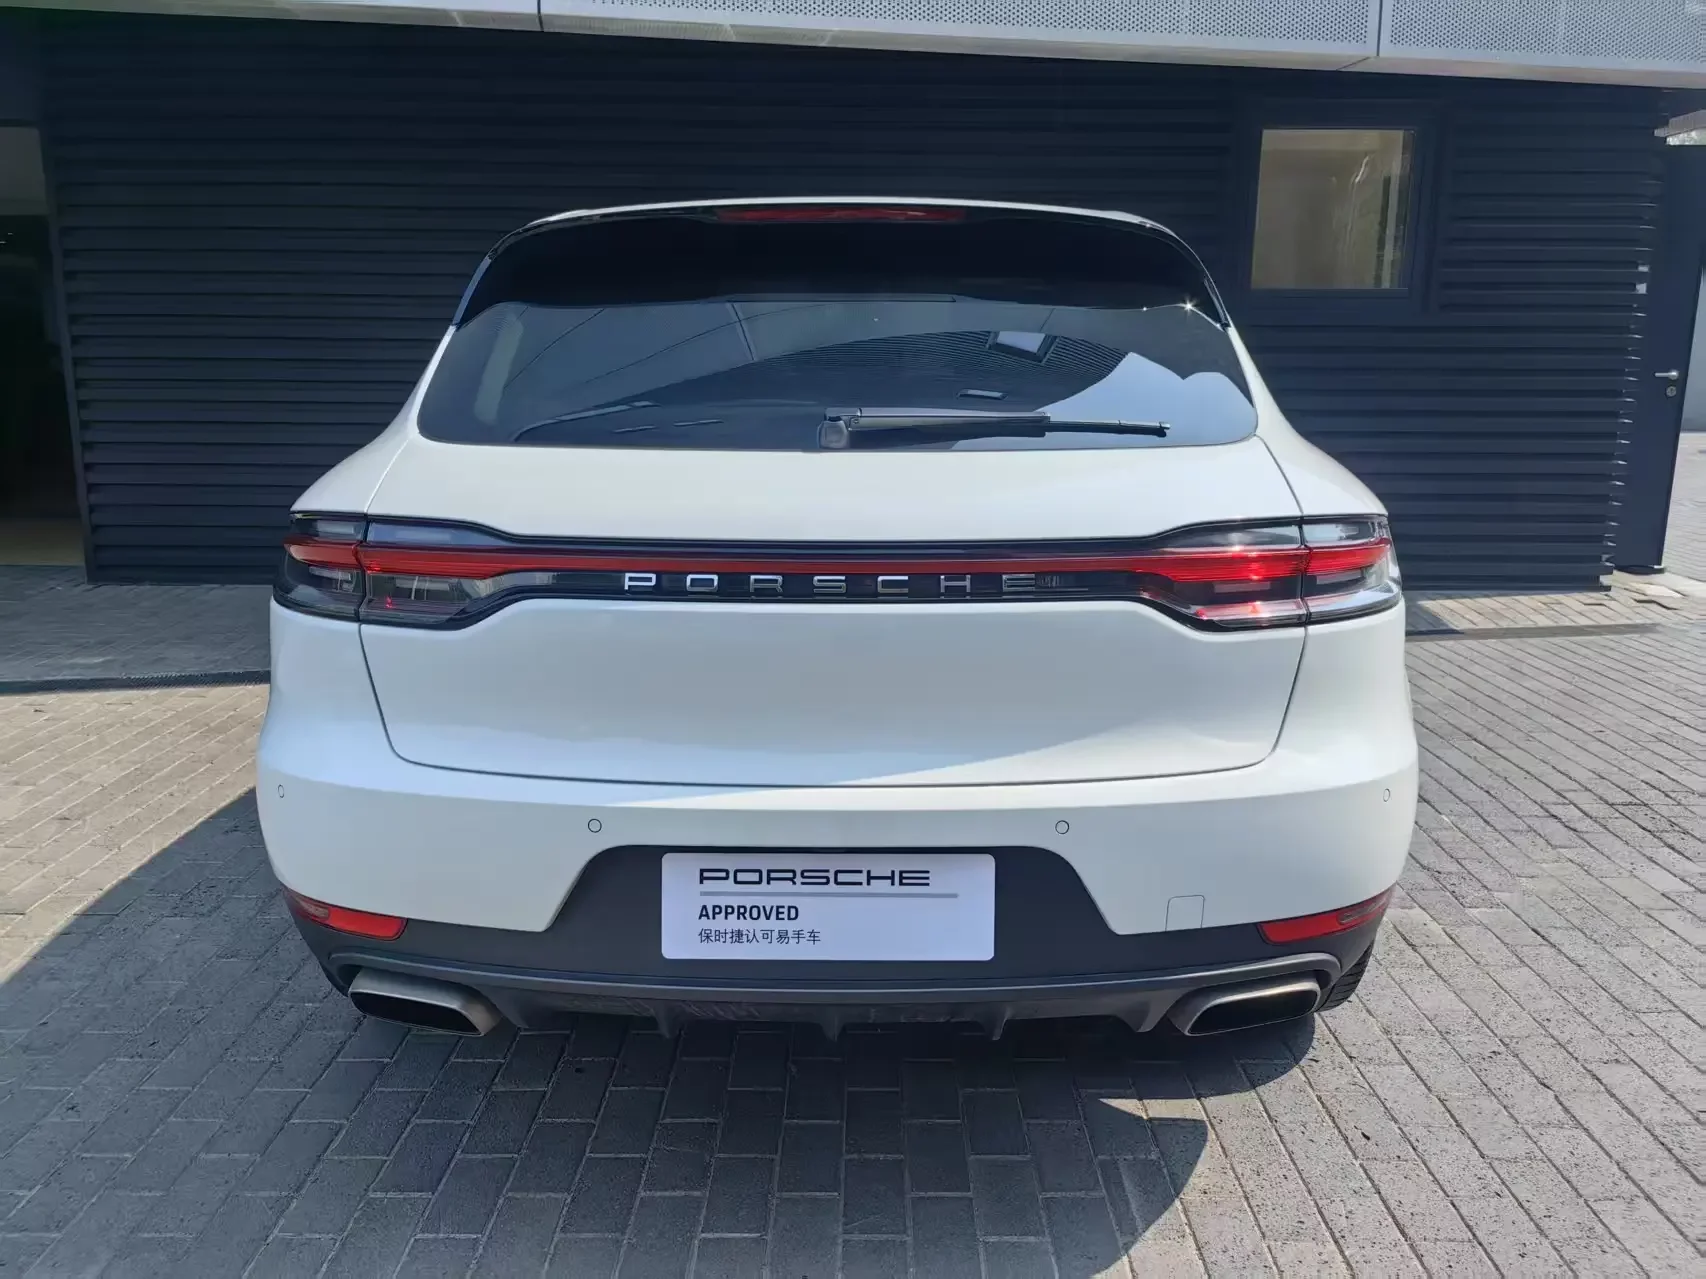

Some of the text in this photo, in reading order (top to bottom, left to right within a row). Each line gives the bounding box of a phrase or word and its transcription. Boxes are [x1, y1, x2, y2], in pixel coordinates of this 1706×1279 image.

[624, 573, 1036, 593] PORSCHE
[699, 868, 930, 886] PORSCHE
[698, 904, 800, 921] APPROVED
[698, 928, 822, 945] 保时捷认可易手车
